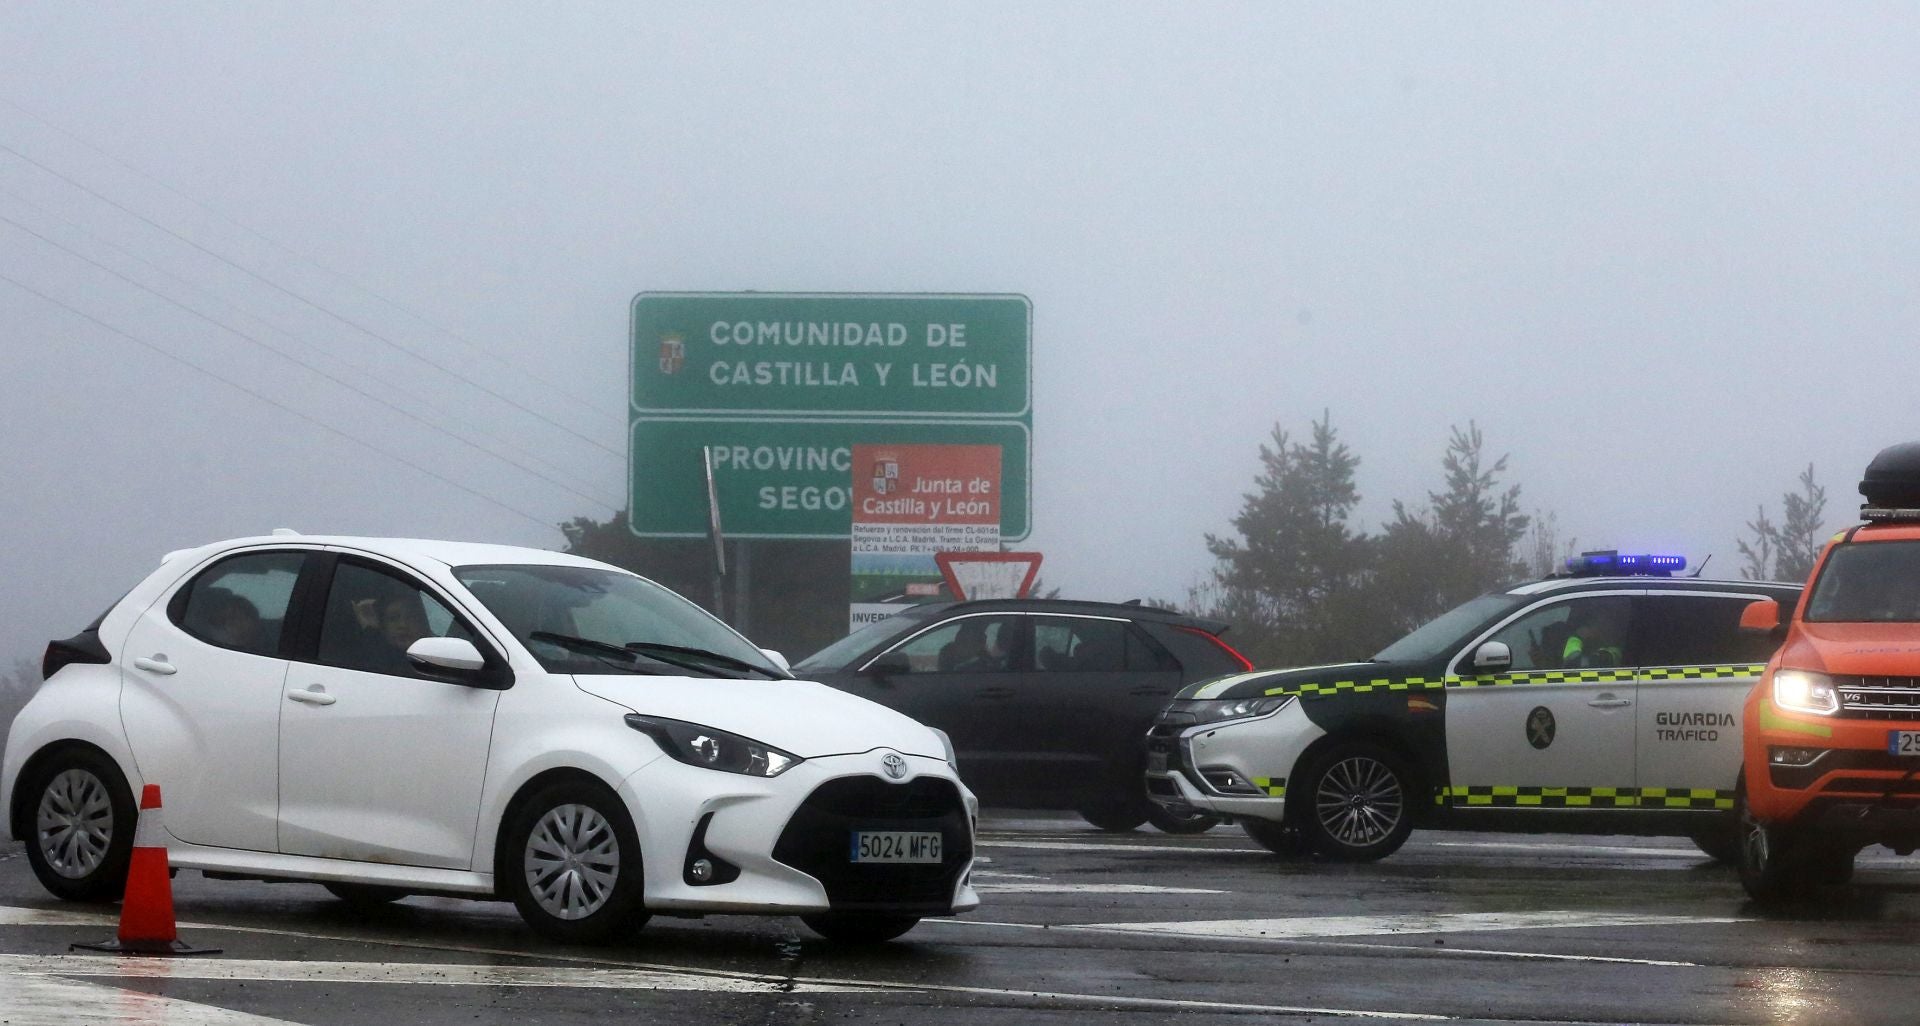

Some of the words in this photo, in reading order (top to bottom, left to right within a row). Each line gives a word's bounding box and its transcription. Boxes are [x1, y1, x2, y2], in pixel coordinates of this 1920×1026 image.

[709, 321, 908, 347] COMUNIDAD
[926, 323, 967, 347] DE
[709, 361, 859, 387] CASTILLA
[875, 363, 893, 387] Y
[912, 358, 998, 388] LEÓN
[912, 477, 962, 493] Junta
[968, 477, 991, 493] de
[759, 486, 853, 510] SEGO
[862, 498, 925, 514] Castilla
[930, 502, 941, 519] y
[946, 496, 990, 515] León
[854, 526, 885, 534] Refuerzo
[887, 527, 891, 535] y
[933, 525, 944, 534] del
[854, 536, 881, 545] Segovia
[1843, 693, 1861, 701] V6
[1656, 712, 1735, 726] GUARDIA
[1657, 727, 1718, 741] TRÁFICO
[861, 835, 904, 858] 5024
[909, 836, 939, 858] MFG
